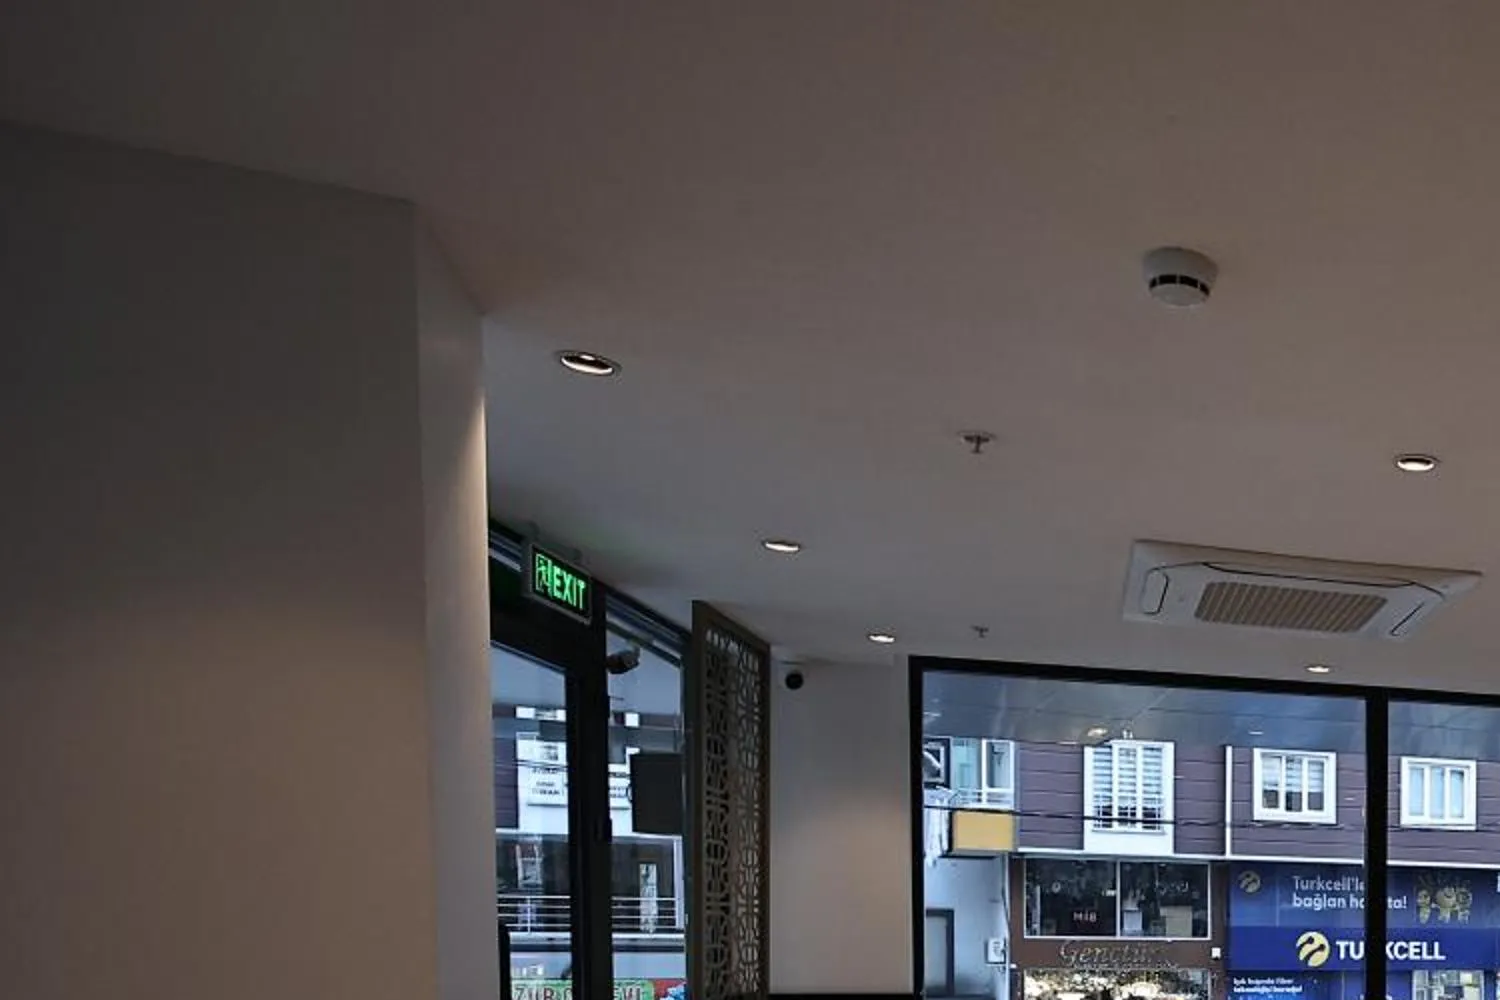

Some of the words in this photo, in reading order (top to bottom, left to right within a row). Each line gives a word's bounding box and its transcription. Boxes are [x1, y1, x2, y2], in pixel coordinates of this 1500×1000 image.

[553, 565, 586, 609] EXIT
[1292, 893, 1346, 911] bağlan
[1335, 939, 1447, 961] TUKCELL
